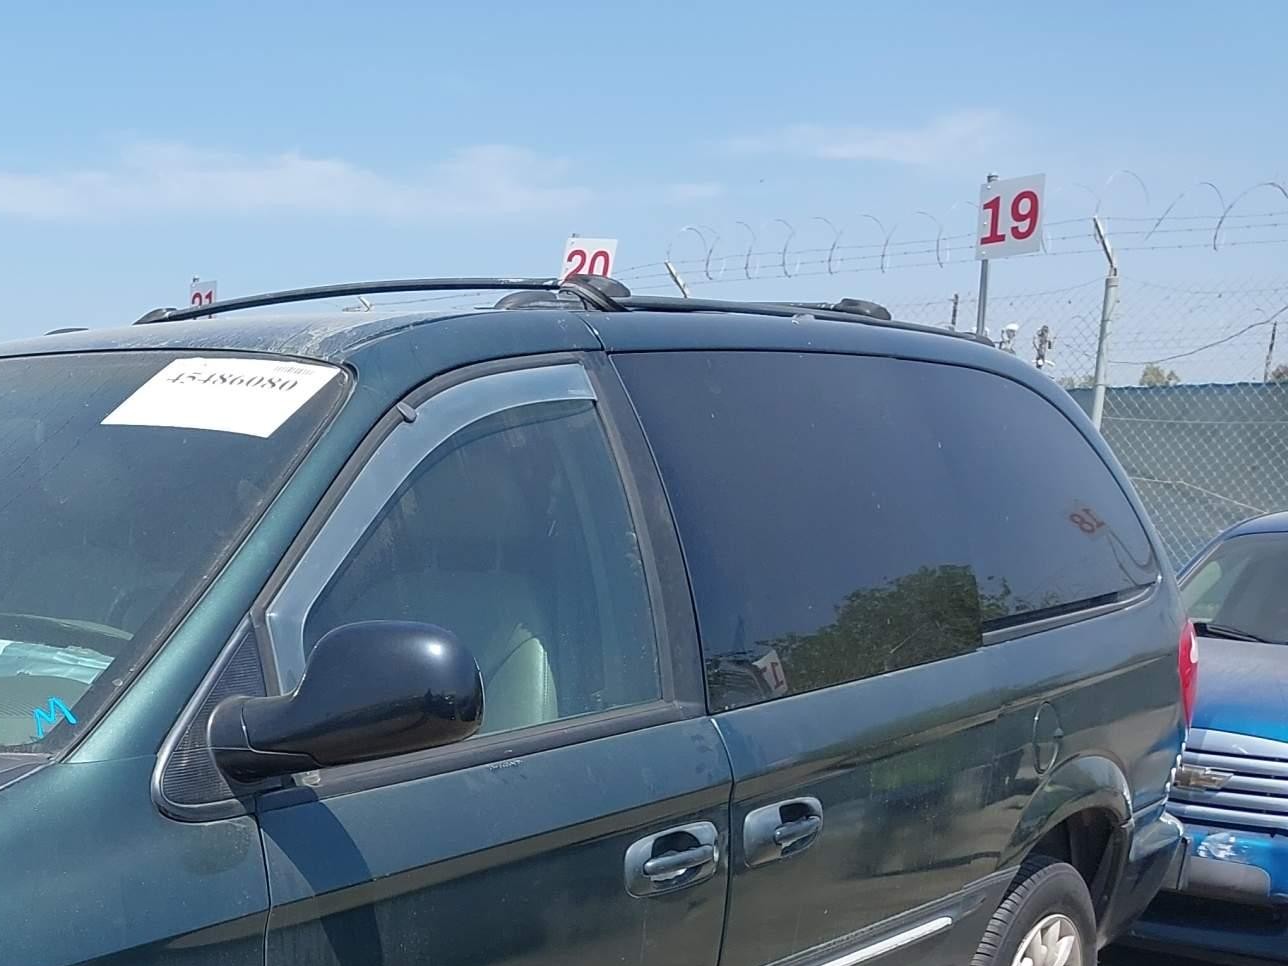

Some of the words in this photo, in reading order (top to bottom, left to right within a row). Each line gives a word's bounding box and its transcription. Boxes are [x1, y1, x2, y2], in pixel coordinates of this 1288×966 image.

[980, 190, 1039, 245] 19
[560, 249, 609, 284] 20
[167, 372, 298, 391] 45486080
[33, 696, 78, 738] M
